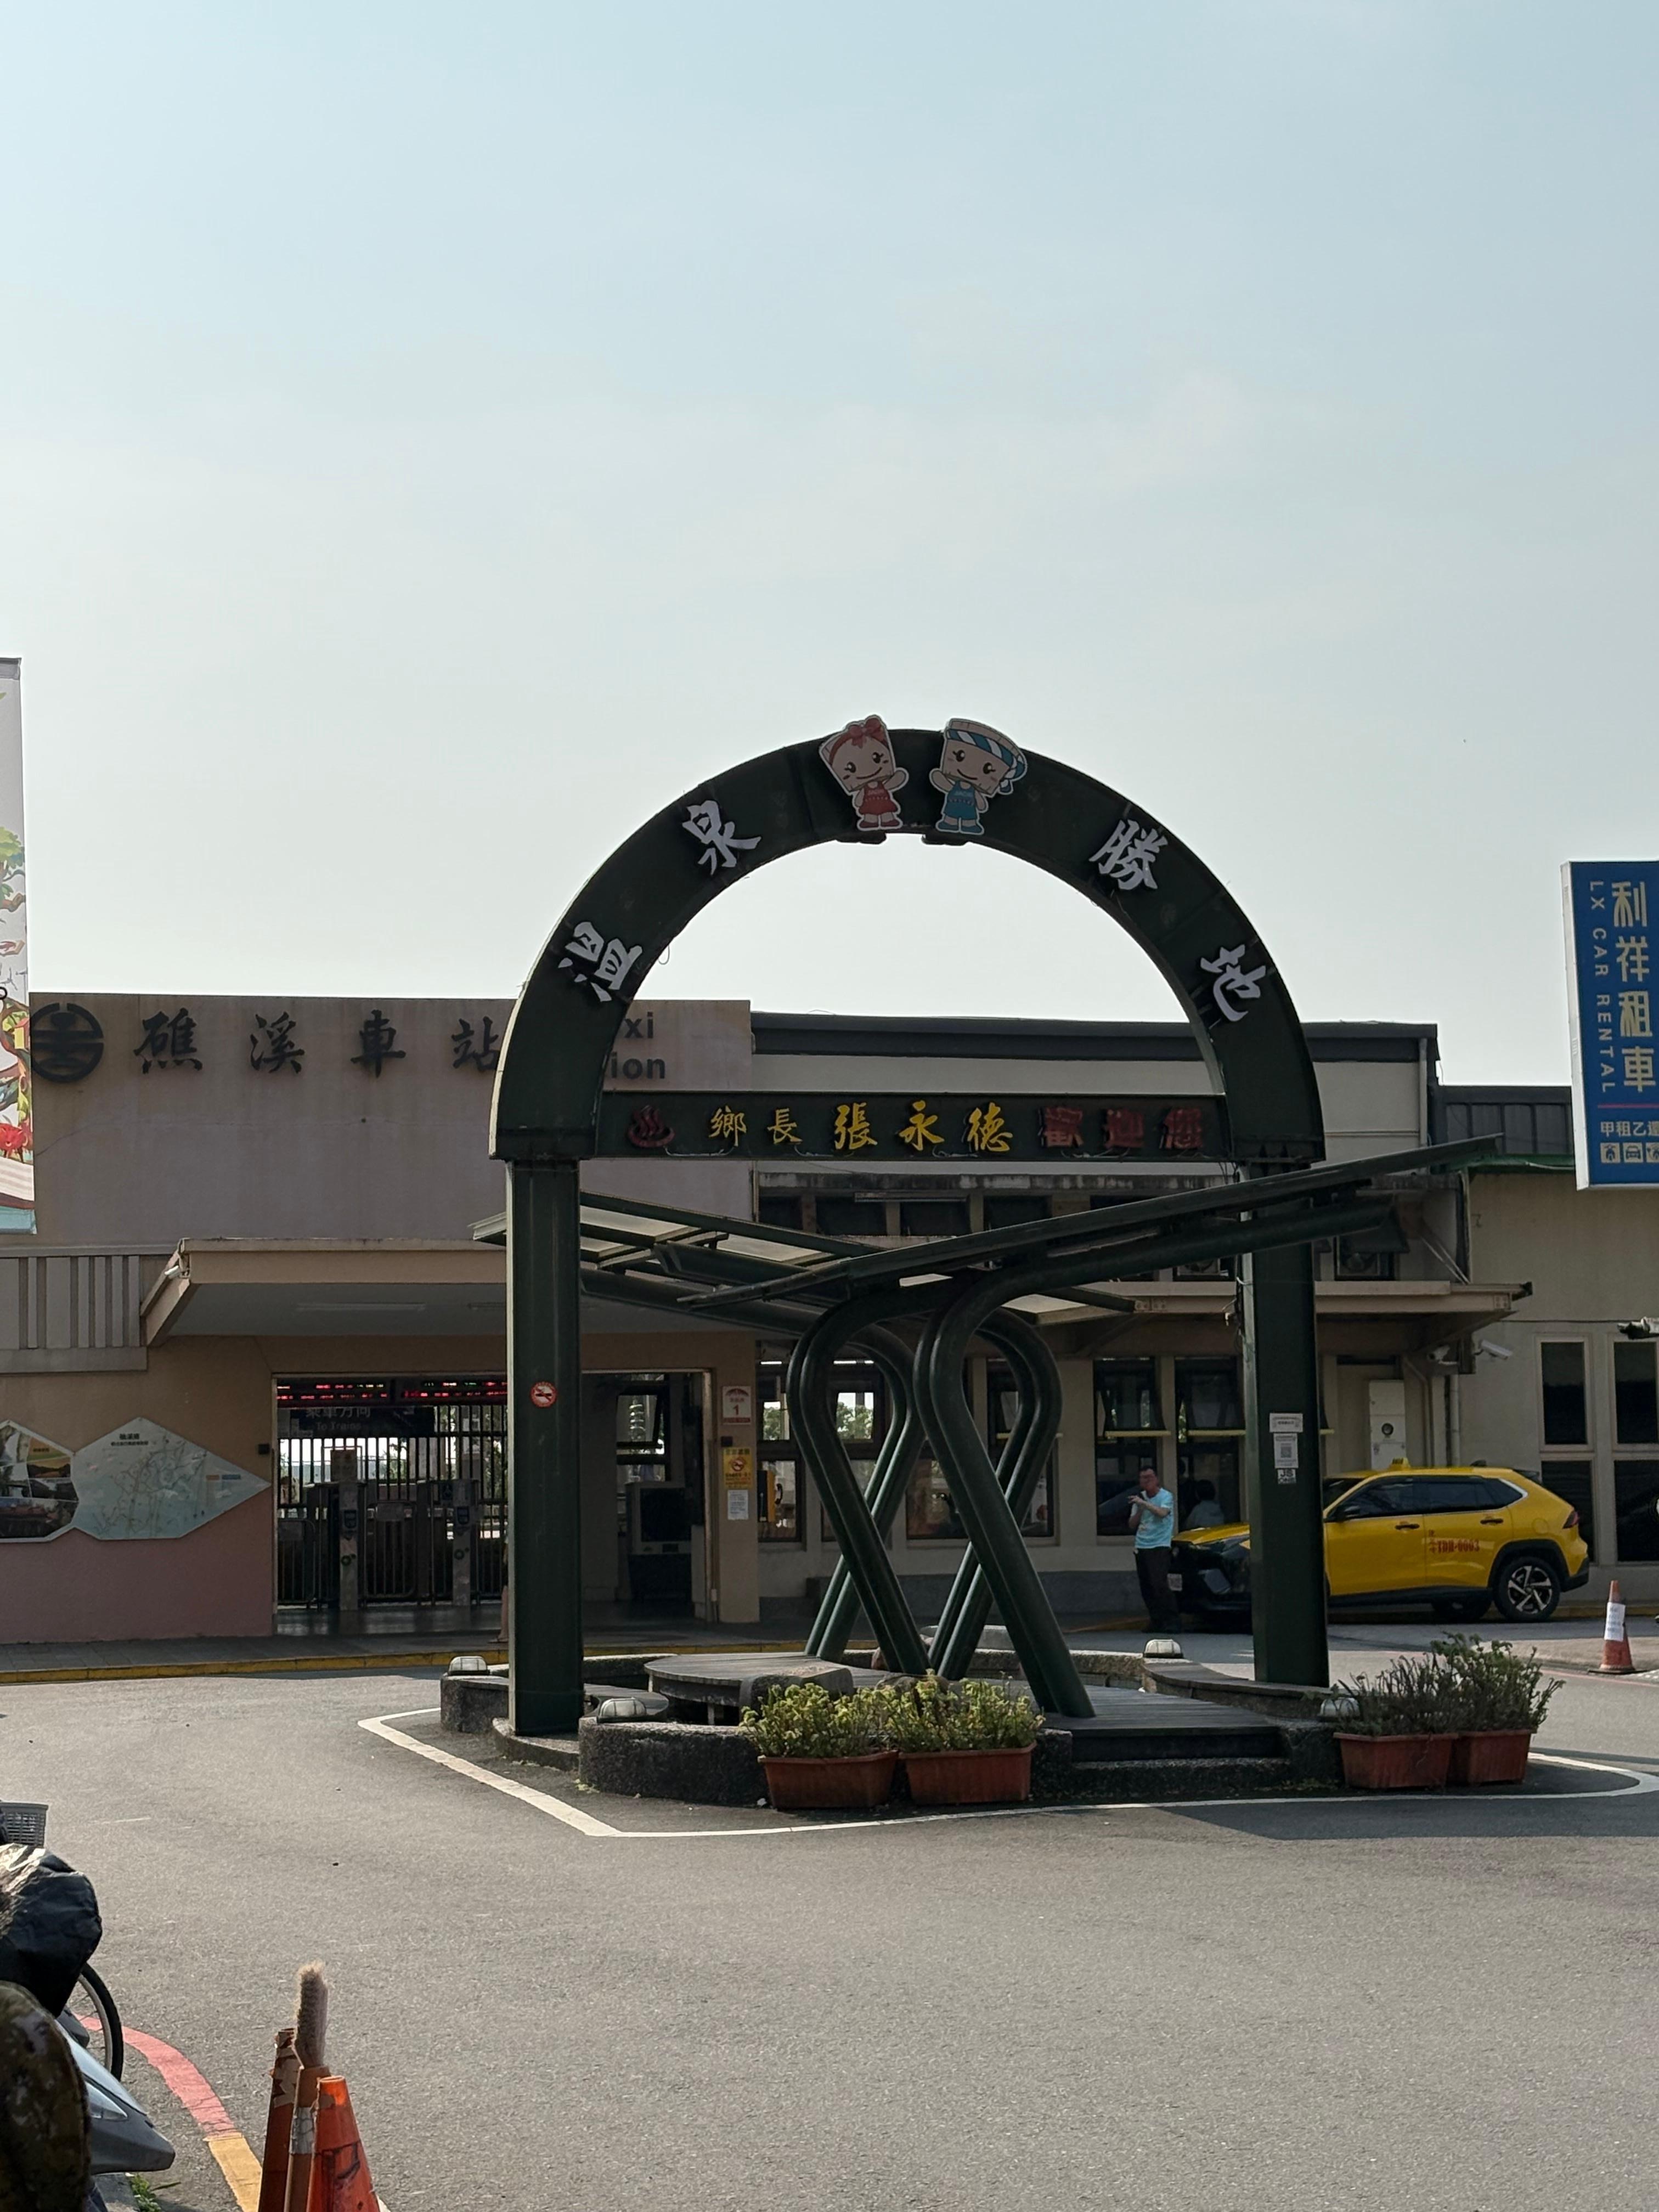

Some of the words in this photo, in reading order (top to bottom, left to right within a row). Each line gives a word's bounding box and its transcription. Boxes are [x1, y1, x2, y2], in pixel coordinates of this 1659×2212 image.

[558, 799, 761, 1002] 溫泉
[1090, 819, 1266, 1023] 勝地
[1590, 881, 1605, 911] LX
[1592, 927, 1610, 977] CAR
[1611, 881, 1656, 1093] 利祥租車
[133, 1007, 499, 1078] 礁溪車站
[1596, 994, 1616, 1093] RENTAL
[732, 1404, 739, 1415] 1
